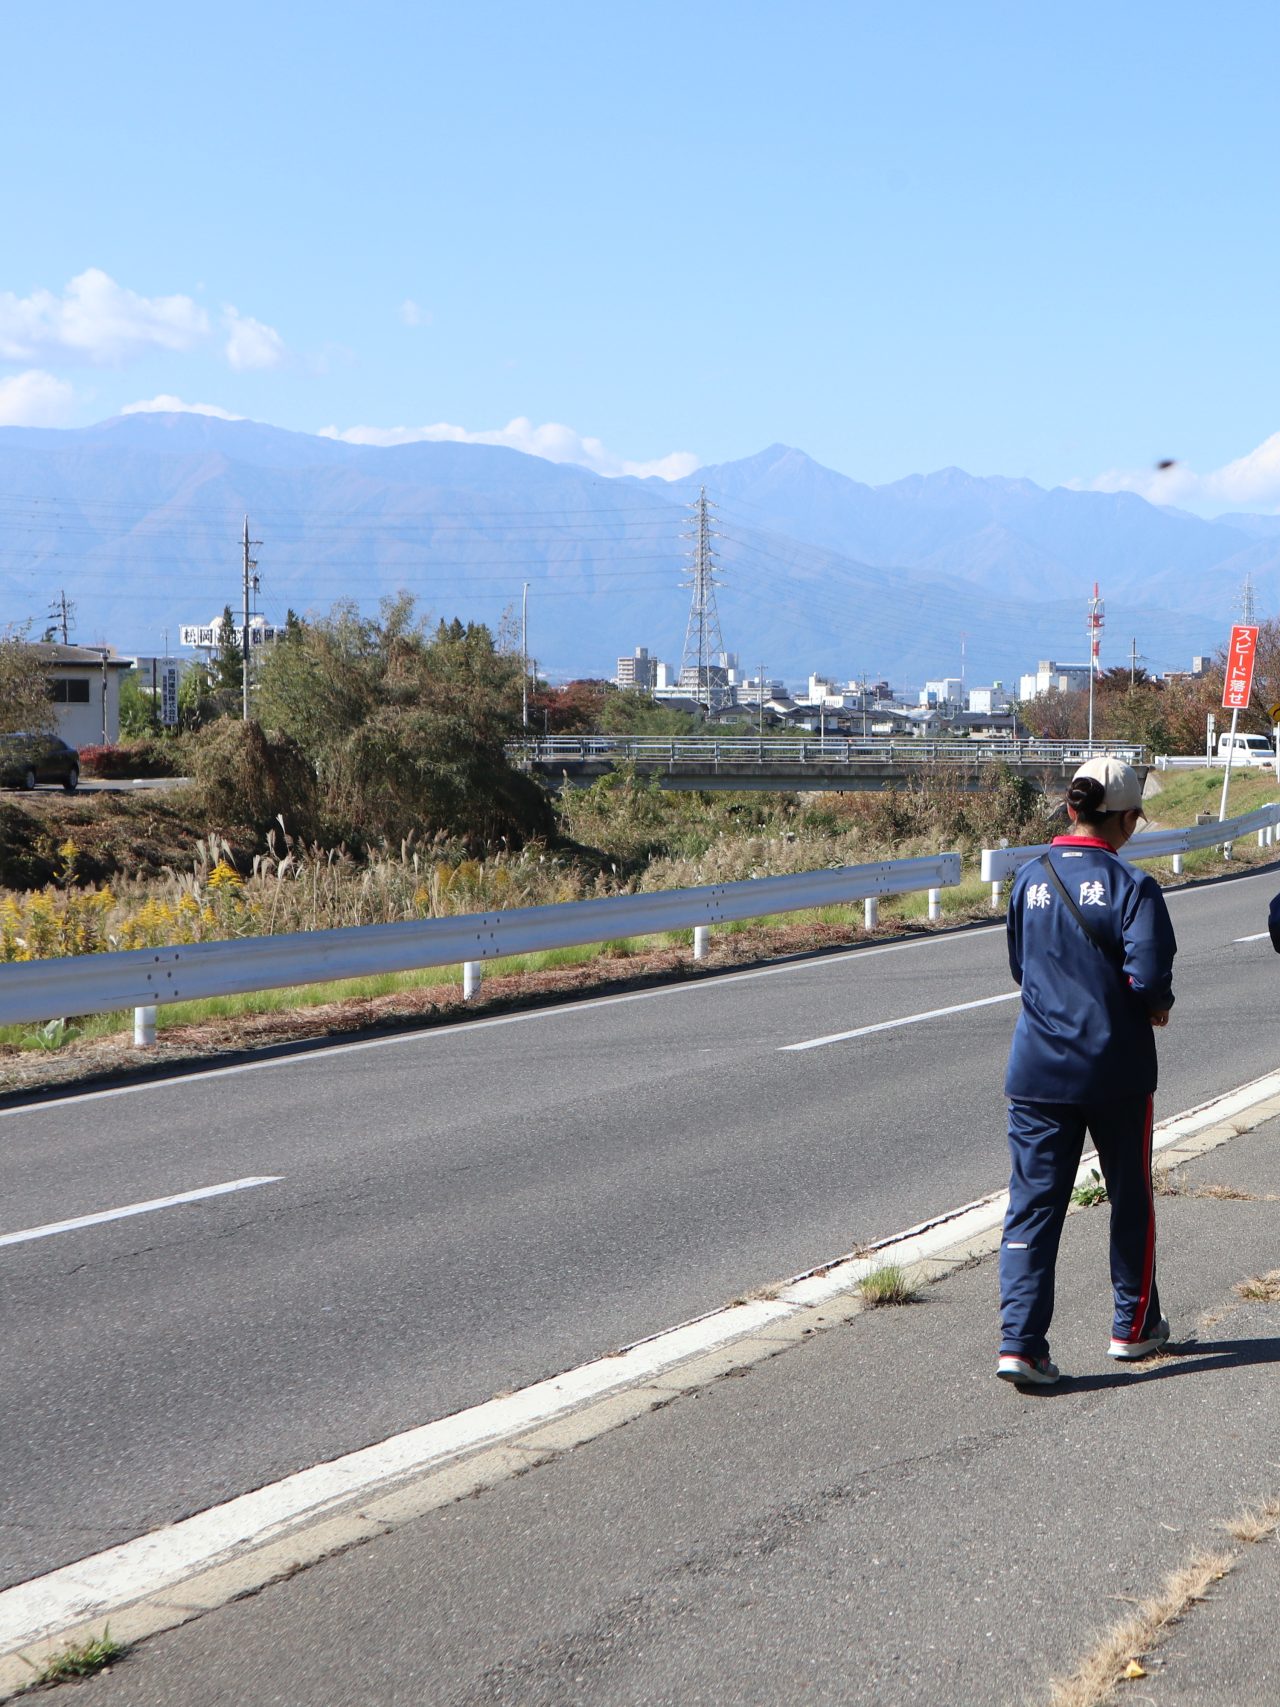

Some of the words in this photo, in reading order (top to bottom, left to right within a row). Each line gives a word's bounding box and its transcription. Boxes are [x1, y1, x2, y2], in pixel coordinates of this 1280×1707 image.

[1228, 629, 1252, 705] スピード落せ
